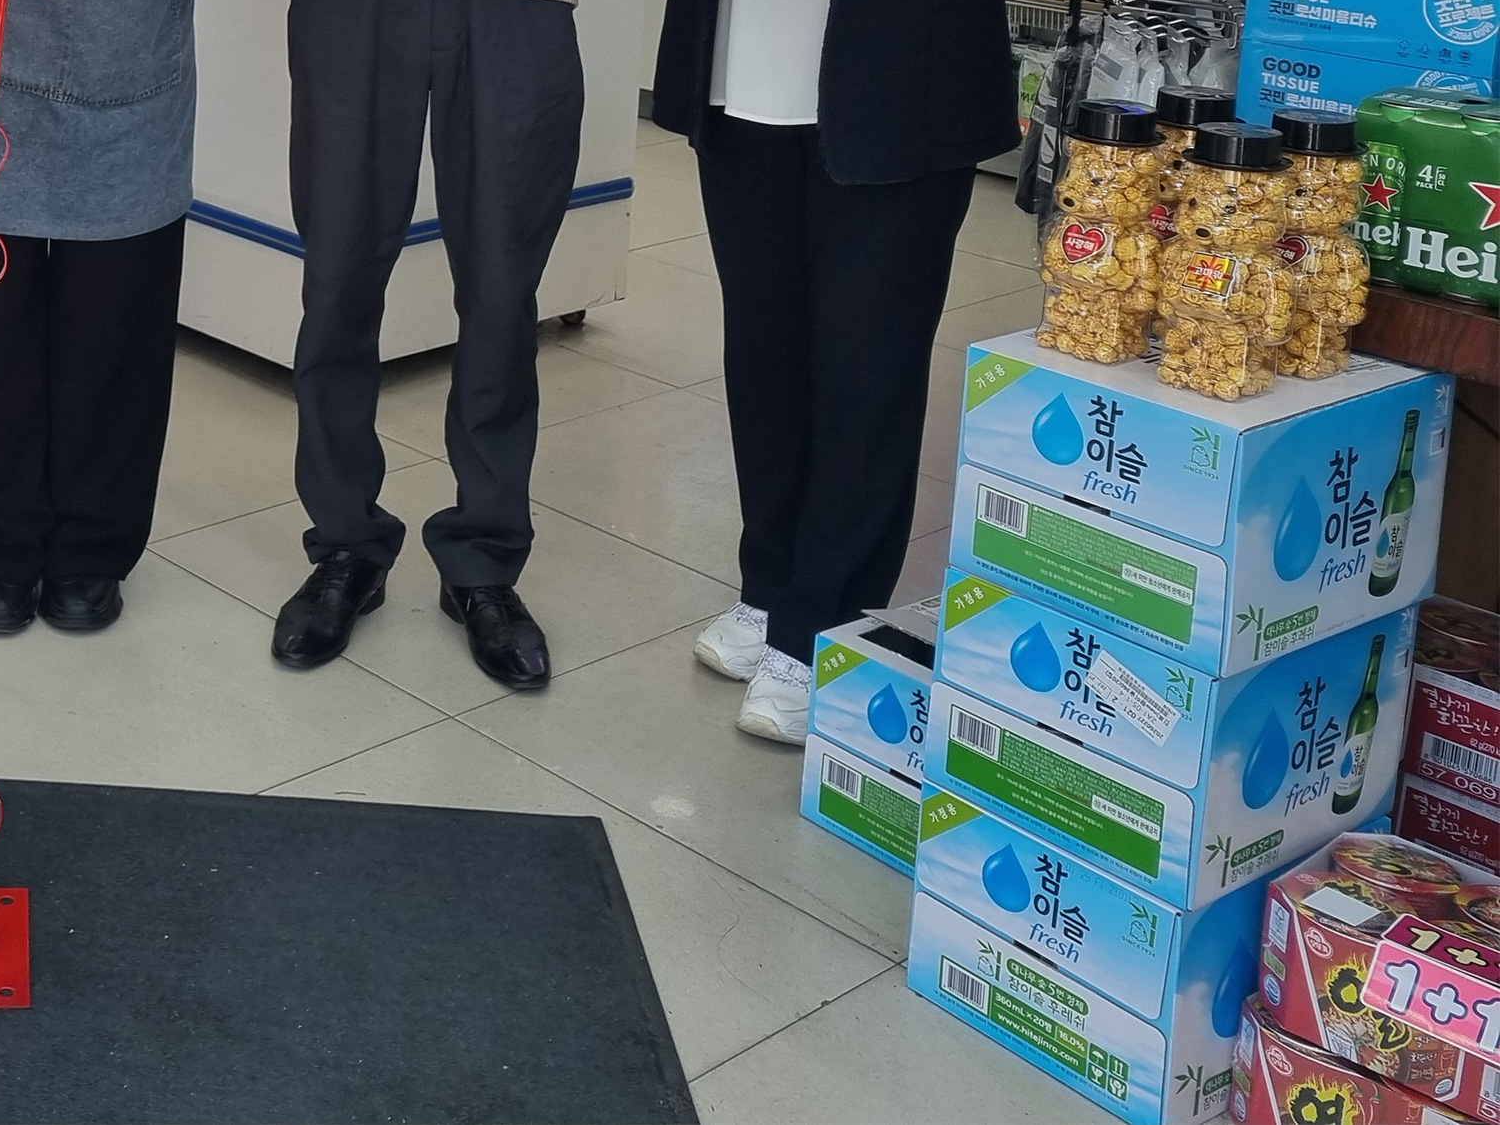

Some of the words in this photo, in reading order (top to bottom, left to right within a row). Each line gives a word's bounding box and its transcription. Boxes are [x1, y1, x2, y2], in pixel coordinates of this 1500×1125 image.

[1436, 4, 1496, 28] 프로젝트
[1261, 73, 1320, 95] TISSUE
[1262, 57, 1321, 79] GOOD
[1416, 181, 1433, 190] PACK
[1418, 165, 1433, 182] 4
[1403, 226, 1499, 284] Hei
[975, 364, 1007, 390] 가정용
[1087, 395, 1124, 438] 참
[1086, 439, 1148, 485] 이슬
[1183, 464, 1202, 475] SINCE
[1326, 446, 1359, 504] 참
[1082, 470, 1138, 505] fresh
[1324, 490, 1378, 550] 이슬
[1318, 548, 1367, 594] fresh
[954, 586, 985, 611] 가정용
[1065, 627, 1101, 670] 참
[1264, 636, 1290, 657] 참이슬
[1290, 626, 1316, 645] 후레쉬
[822, 652, 846, 672] 가정용
[1058, 700, 1113, 738] fresh
[1295, 676, 1326, 731] 참
[1423, 687, 1470, 713] 열나게
[1437, 708, 1499, 737] 화끈한!
[1291, 717, 1342, 773] 이슬
[1284, 771, 1330, 817] fresh
[1421, 762, 1446, 780] 57
[1454, 774, 1498, 801] 069
[928, 802, 958, 824] 가정용
[1413, 793, 1461, 821] 열나게
[1034, 853, 1068, 897] 참
[1231, 864, 1253, 882] 참이슬
[1033, 893, 1091, 946] 이슬
[1028, 922, 1081, 965] fresh
[1122, 935, 1141, 950] SINCE
[1008, 975, 1044, 1006] 참이슬
[1047, 999, 1086, 1032] 후레쉬
[1012, 962, 1038, 984] 대나무
[1039, 976, 1048, 989] 숯
[1049, 982, 1066, 1002] 5번
[1067, 992, 1085, 1013] 정제
[1384, 959, 1500, 1055] 1+1
[997, 1012, 1080, 1066] www.hitejinro.com
